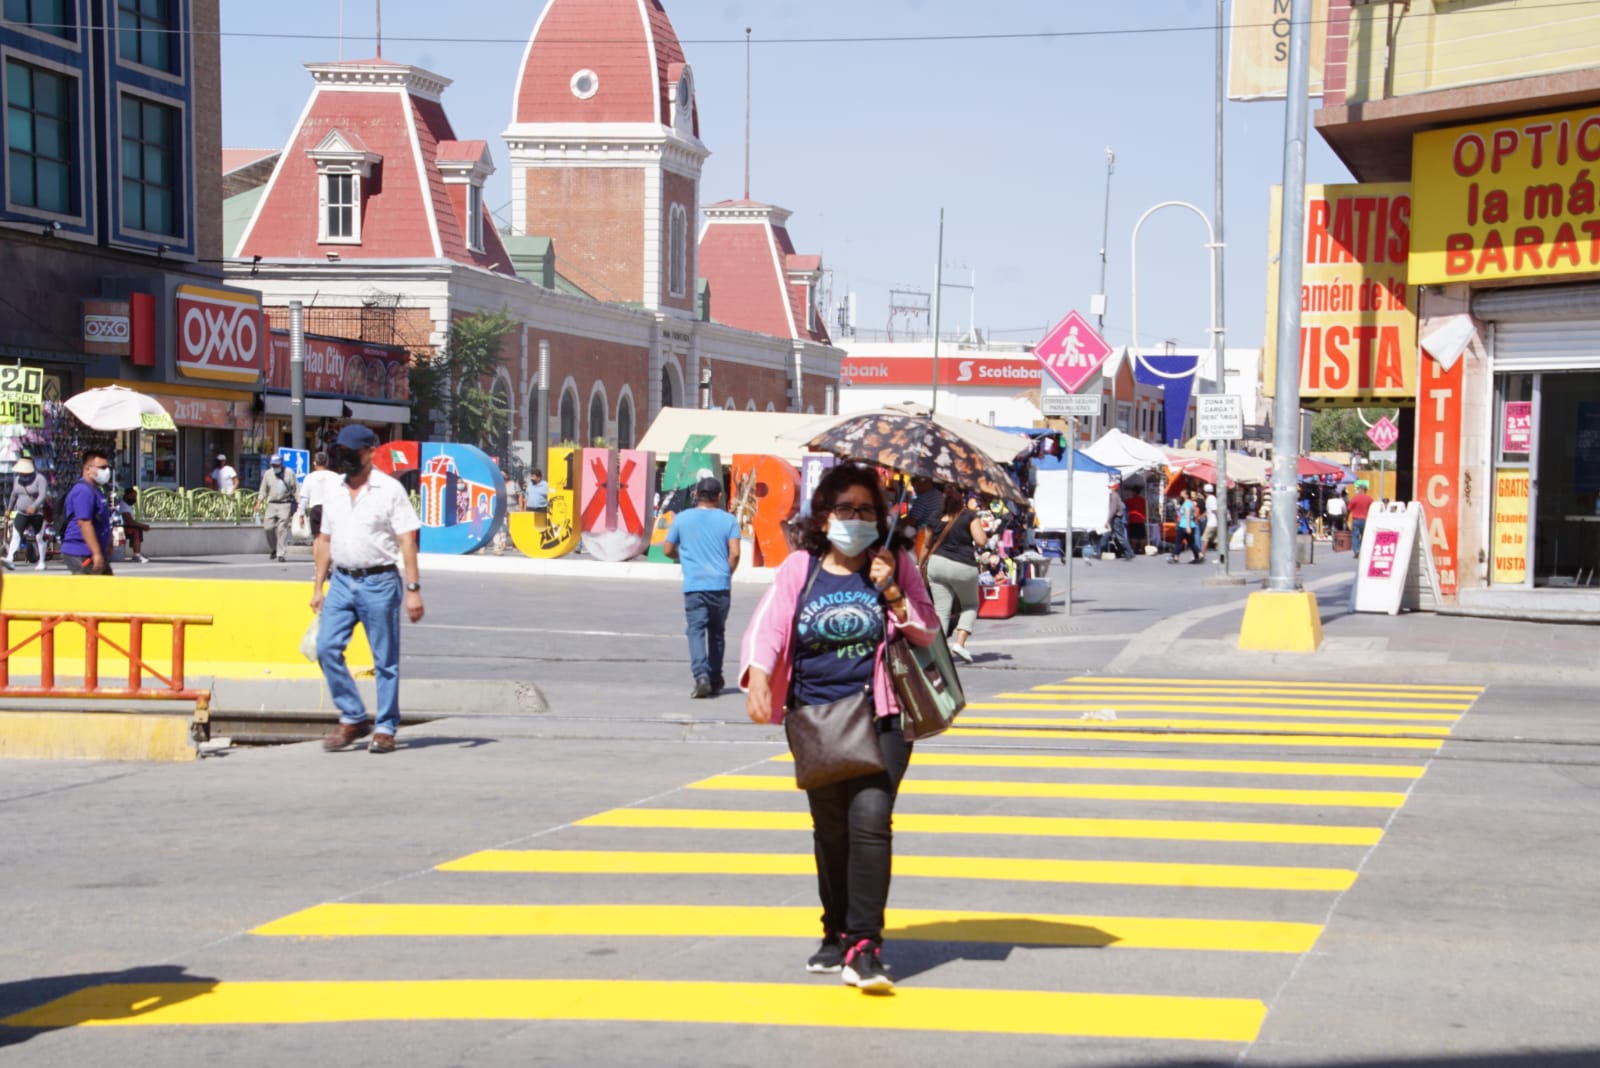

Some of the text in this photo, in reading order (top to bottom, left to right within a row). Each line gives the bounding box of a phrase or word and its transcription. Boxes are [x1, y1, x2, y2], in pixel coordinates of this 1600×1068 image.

[1468, 168, 1600, 226] la má
[1358, 277, 1384, 312] de
[1387, 276, 1406, 311] la
[86, 321, 128, 338] OXXO
[184, 306, 257, 367] OXXO
[326, 346, 345, 381] City
[2, 367, 41, 394] 20
[1498, 478, 1529, 498] GRATIS
[1496, 556, 1526, 571] VISTA
